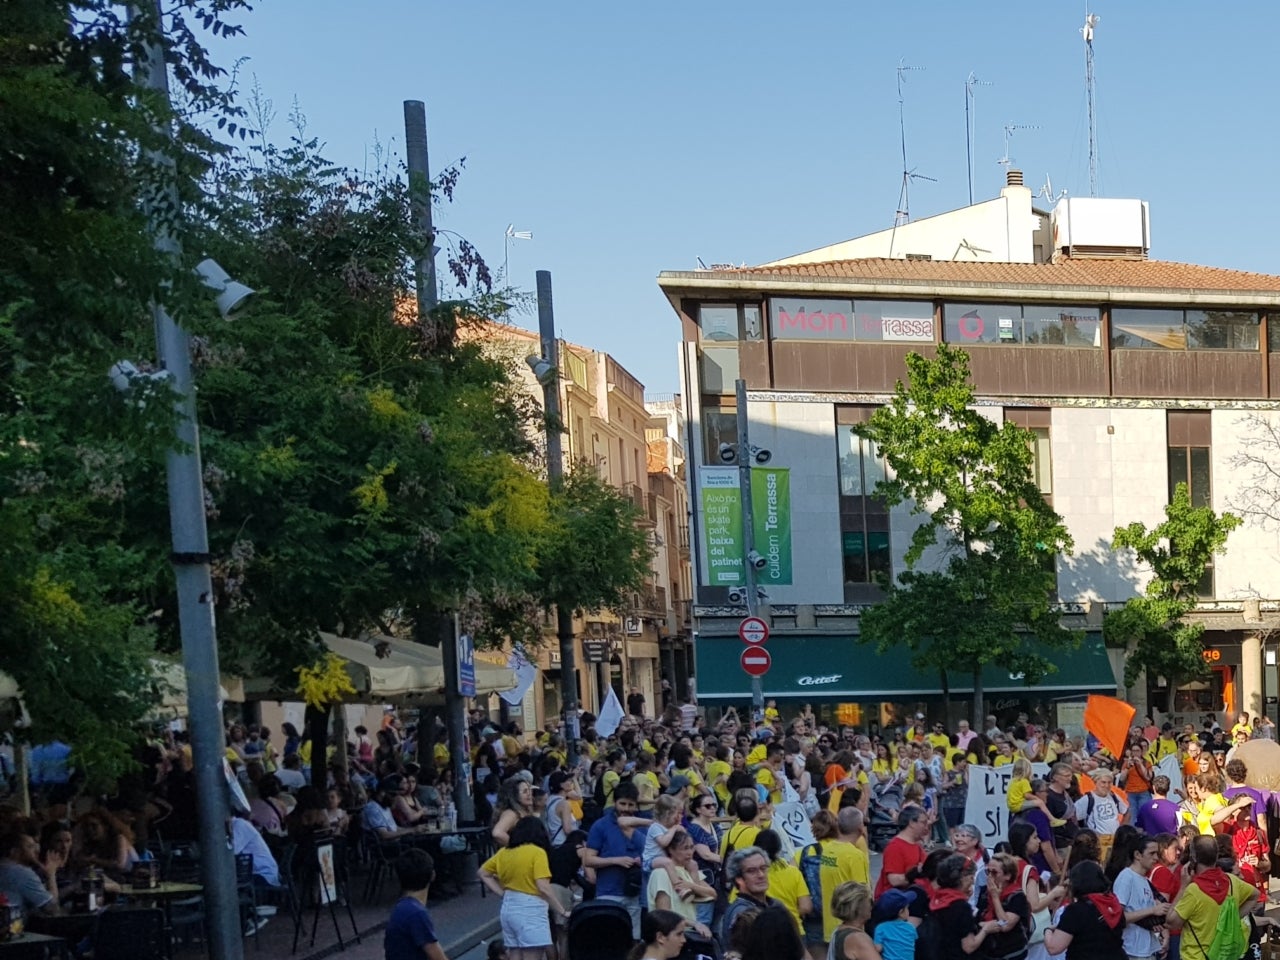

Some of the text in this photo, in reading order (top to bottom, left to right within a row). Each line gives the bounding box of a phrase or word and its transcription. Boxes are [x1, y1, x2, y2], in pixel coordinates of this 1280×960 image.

[778, 305, 847, 332] Món
[706, 494, 724, 503] Això
[765, 474, 780, 579] cuidem Terrassa
[710, 537, 734, 545] baixa
[711, 547, 725, 556] del
[712, 557, 743, 568] patinet
